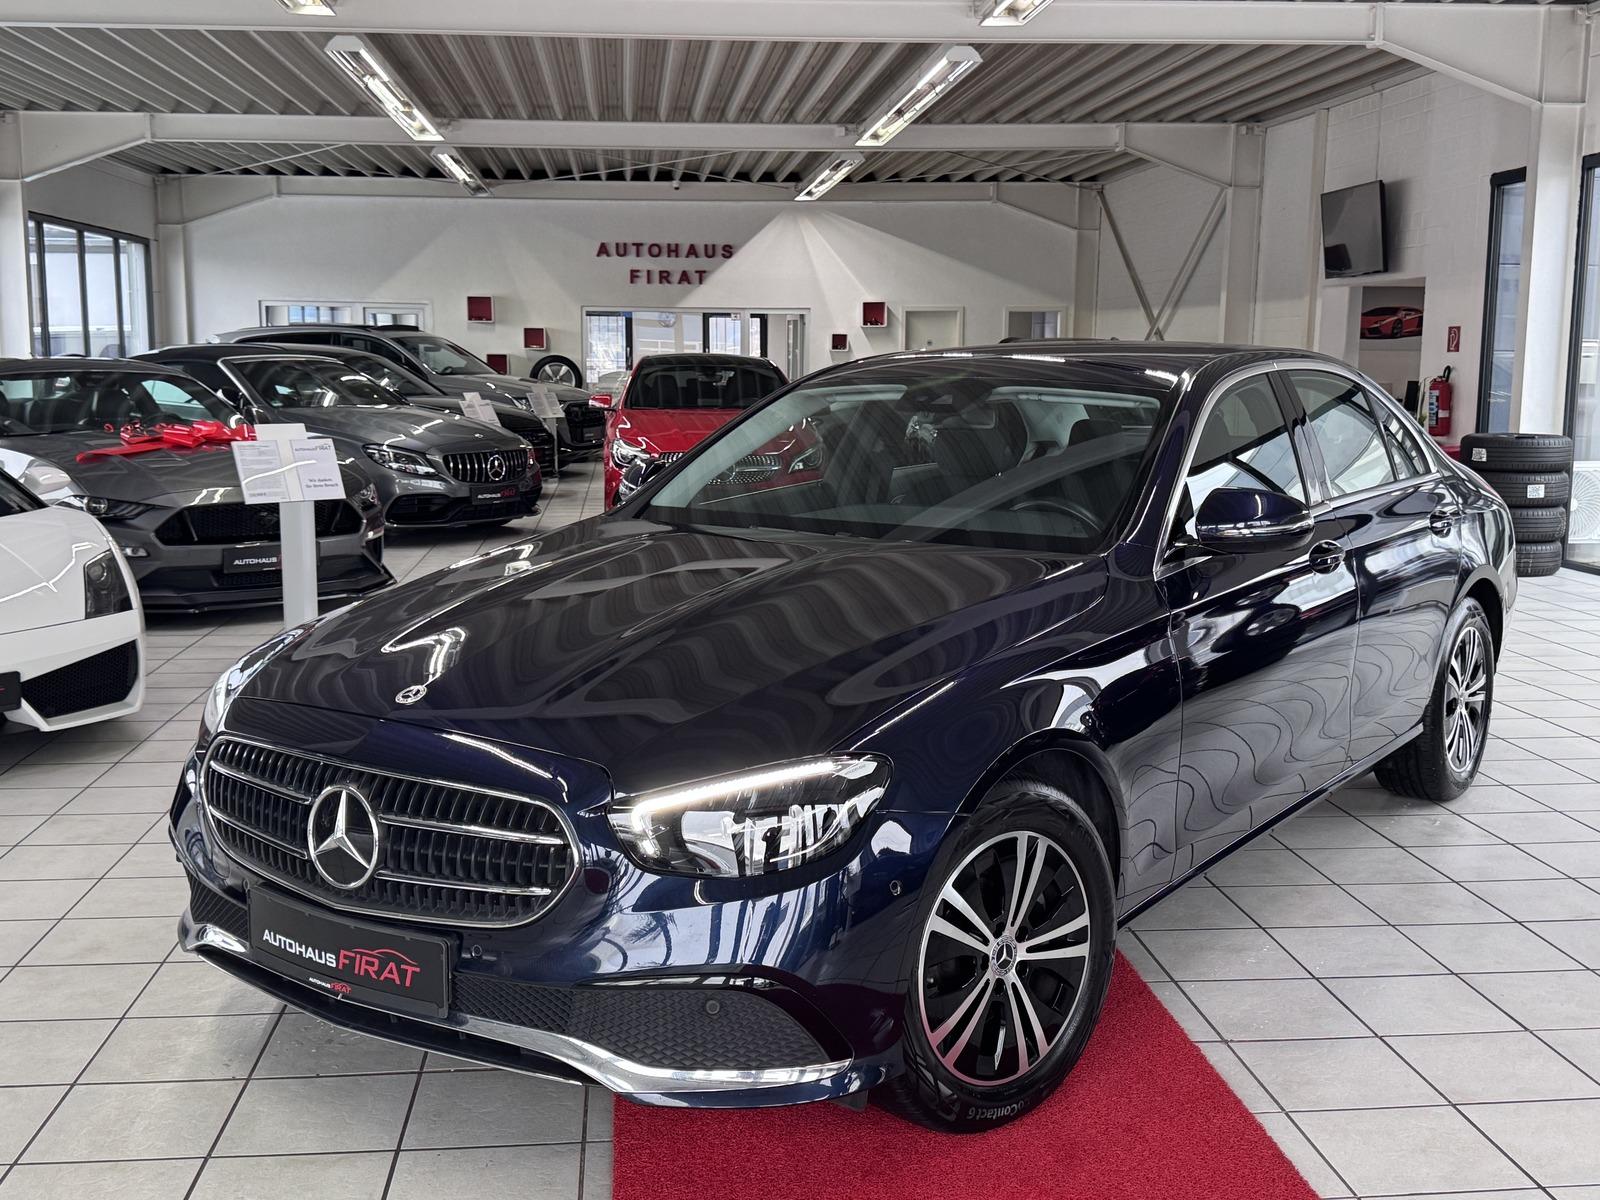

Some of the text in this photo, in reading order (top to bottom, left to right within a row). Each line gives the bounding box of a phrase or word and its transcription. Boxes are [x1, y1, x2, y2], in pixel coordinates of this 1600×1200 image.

[596, 242, 734, 259] AUTOHAUS
[629, 269, 707, 285] FIRAT
[233, 557, 277, 565] AUTOHAUS
[262, 929, 421, 988] AUTOHAUS FIRAT
